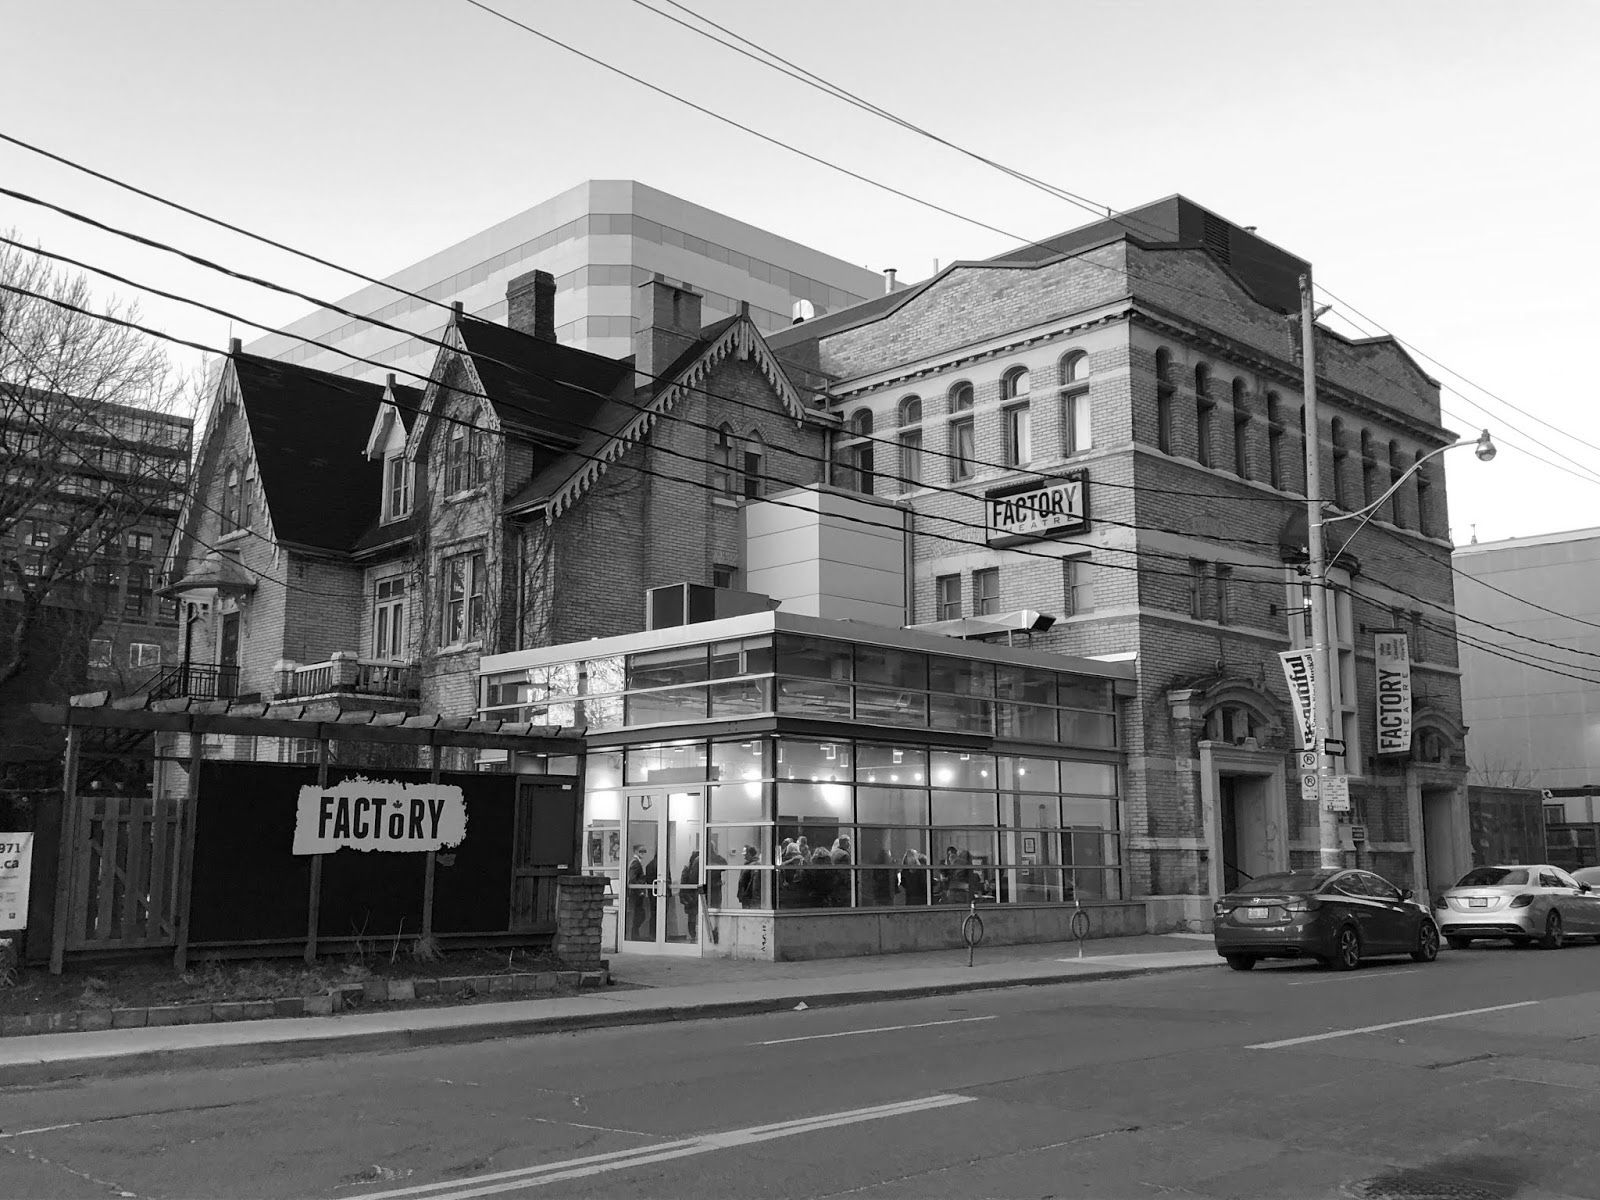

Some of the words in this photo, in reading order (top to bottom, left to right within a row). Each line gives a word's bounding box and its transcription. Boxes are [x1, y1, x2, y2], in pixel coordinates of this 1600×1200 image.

[993, 485, 1077, 527] FACTORY
[1284, 655, 1312, 744] Beautiful
[1379, 668, 1402, 749] FACTORY
[1401, 672, 1410, 746] THEATRE
[318, 796, 445, 839] FACTORY
